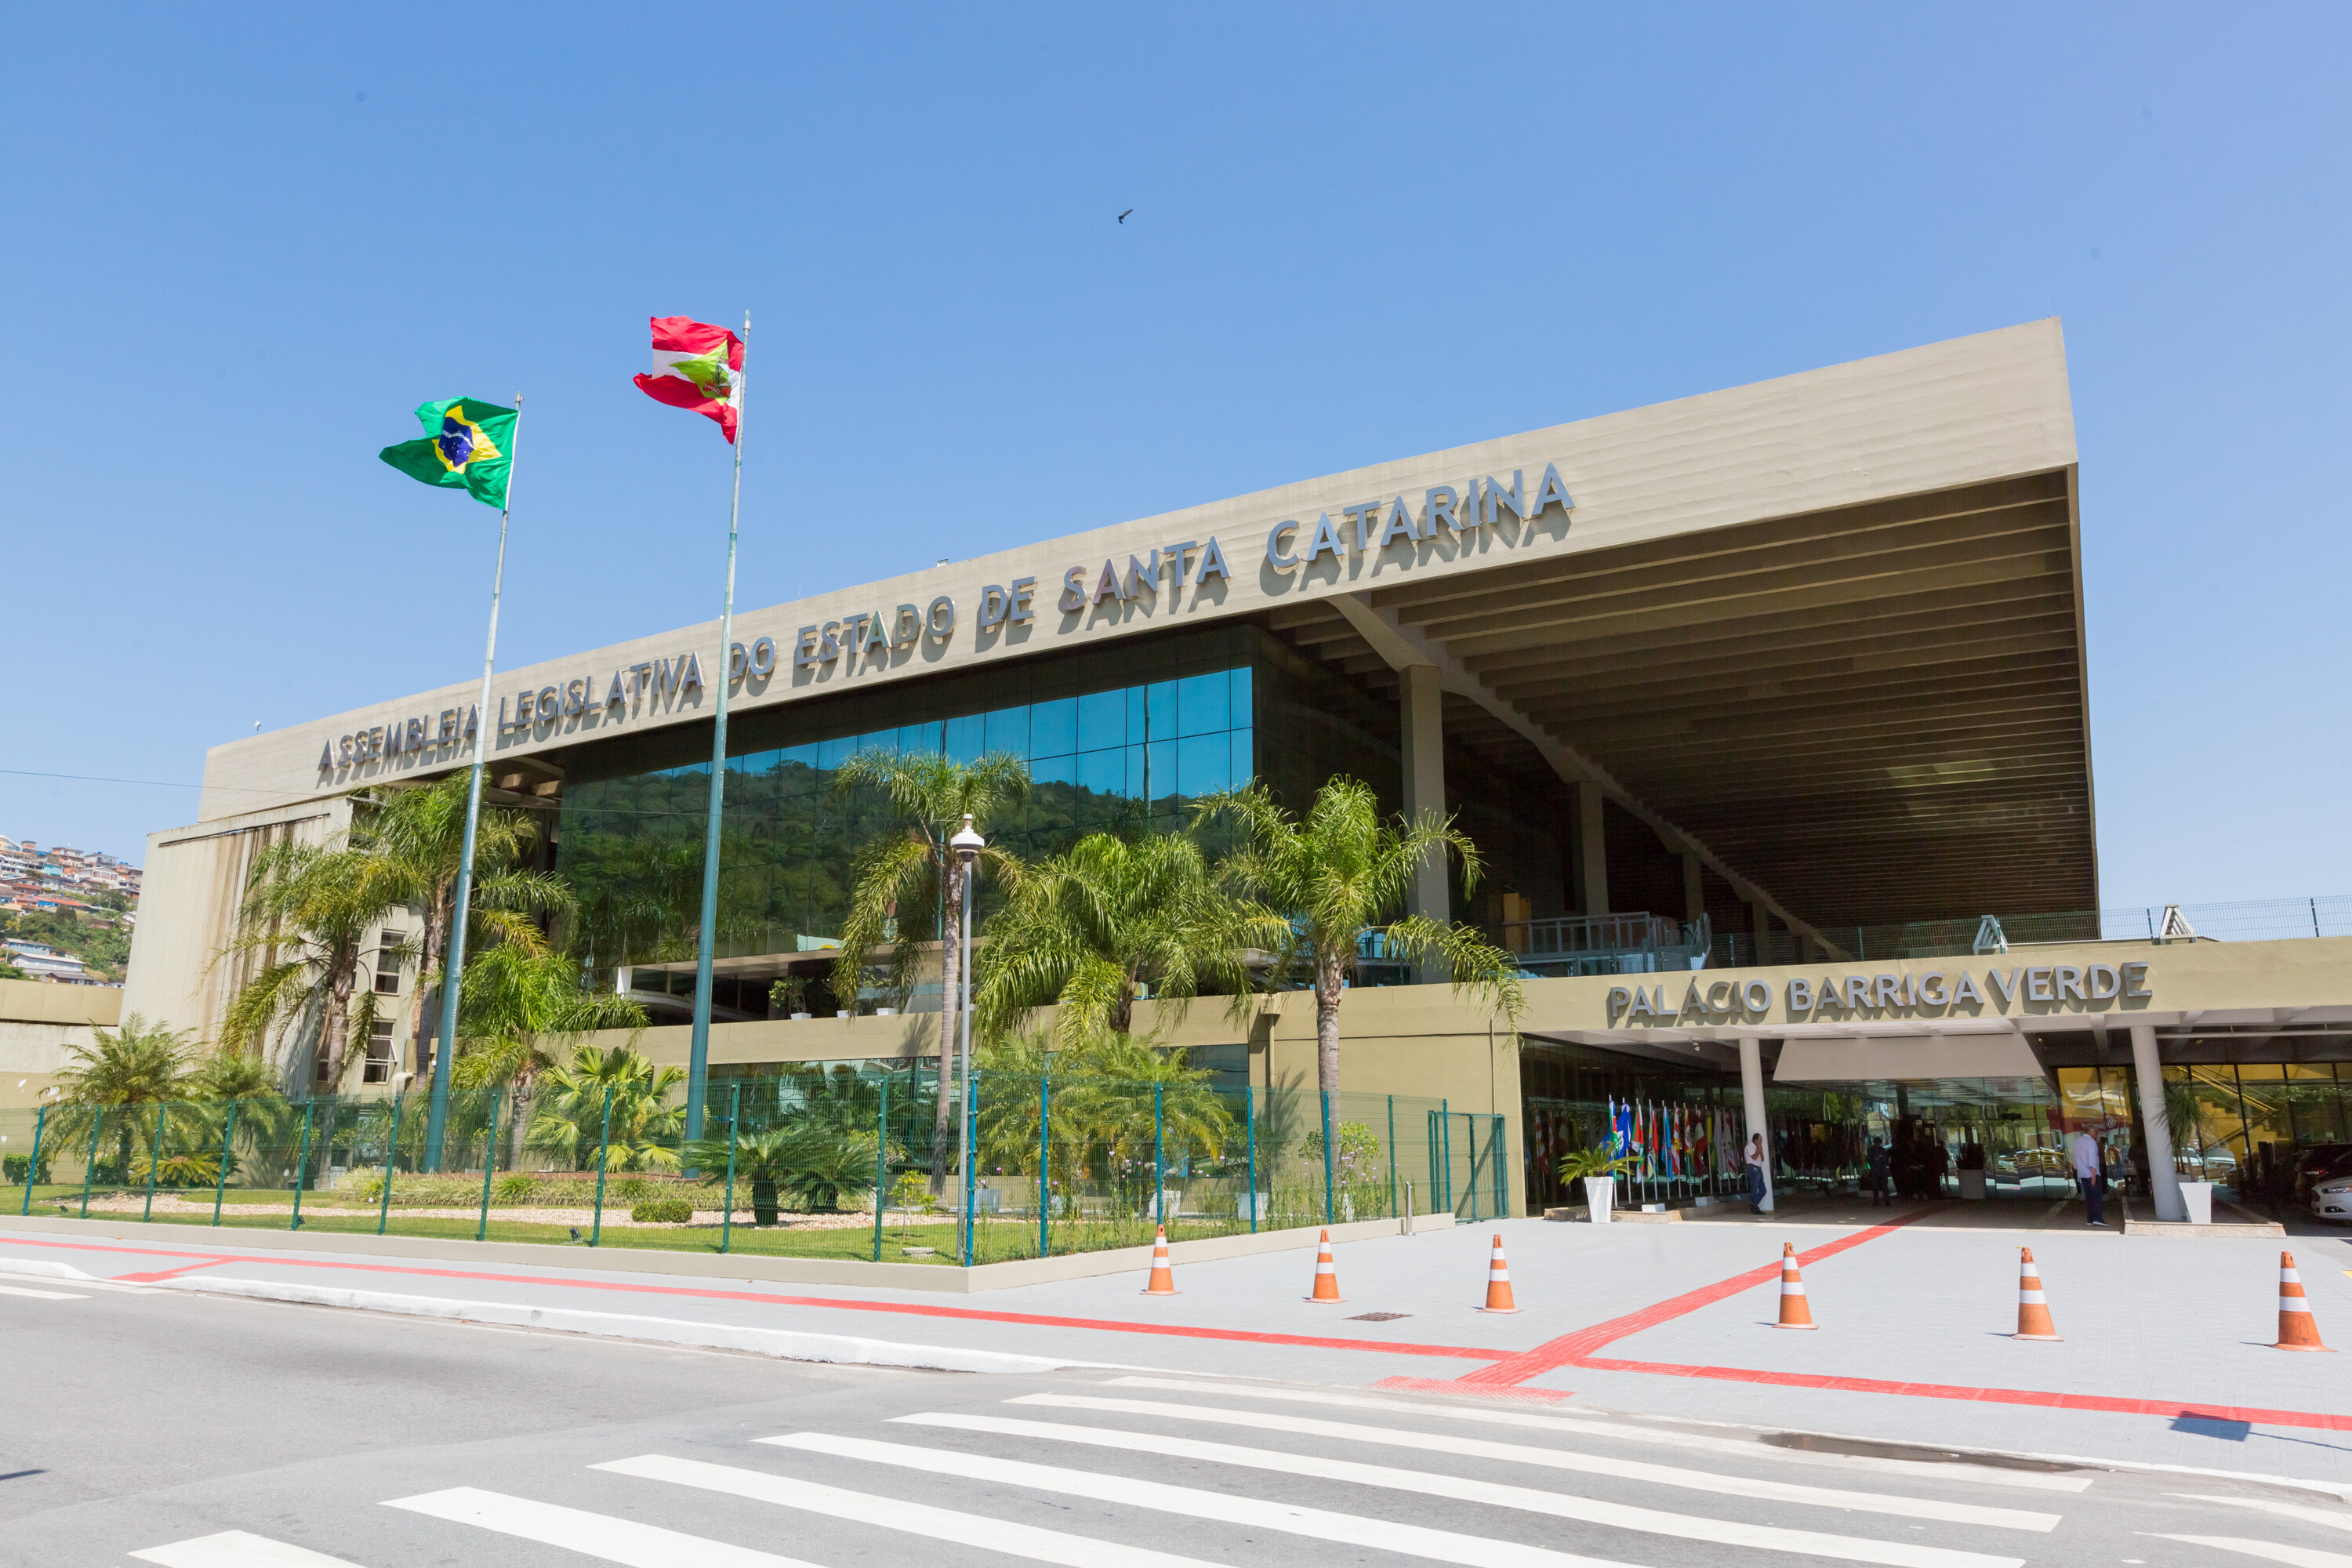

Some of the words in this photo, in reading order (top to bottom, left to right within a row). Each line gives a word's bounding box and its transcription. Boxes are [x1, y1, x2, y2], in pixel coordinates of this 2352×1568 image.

[318, 702, 479, 771] ASSEMBLEIA
[498, 652, 705, 729] LEGISLATIVA
[728, 636, 776, 680] DO
[795, 595, 956, 666] ESTADO
[980, 575, 1039, 630] DE
[1062, 535, 1231, 612] SANTA
[1267, 462, 1576, 568] CATARINA
[1611, 976, 1772, 1018] PALÁCIO
[1788, 971, 1984, 1011] BARRIGA
[1991, 961, 2153, 1003] VERDE
